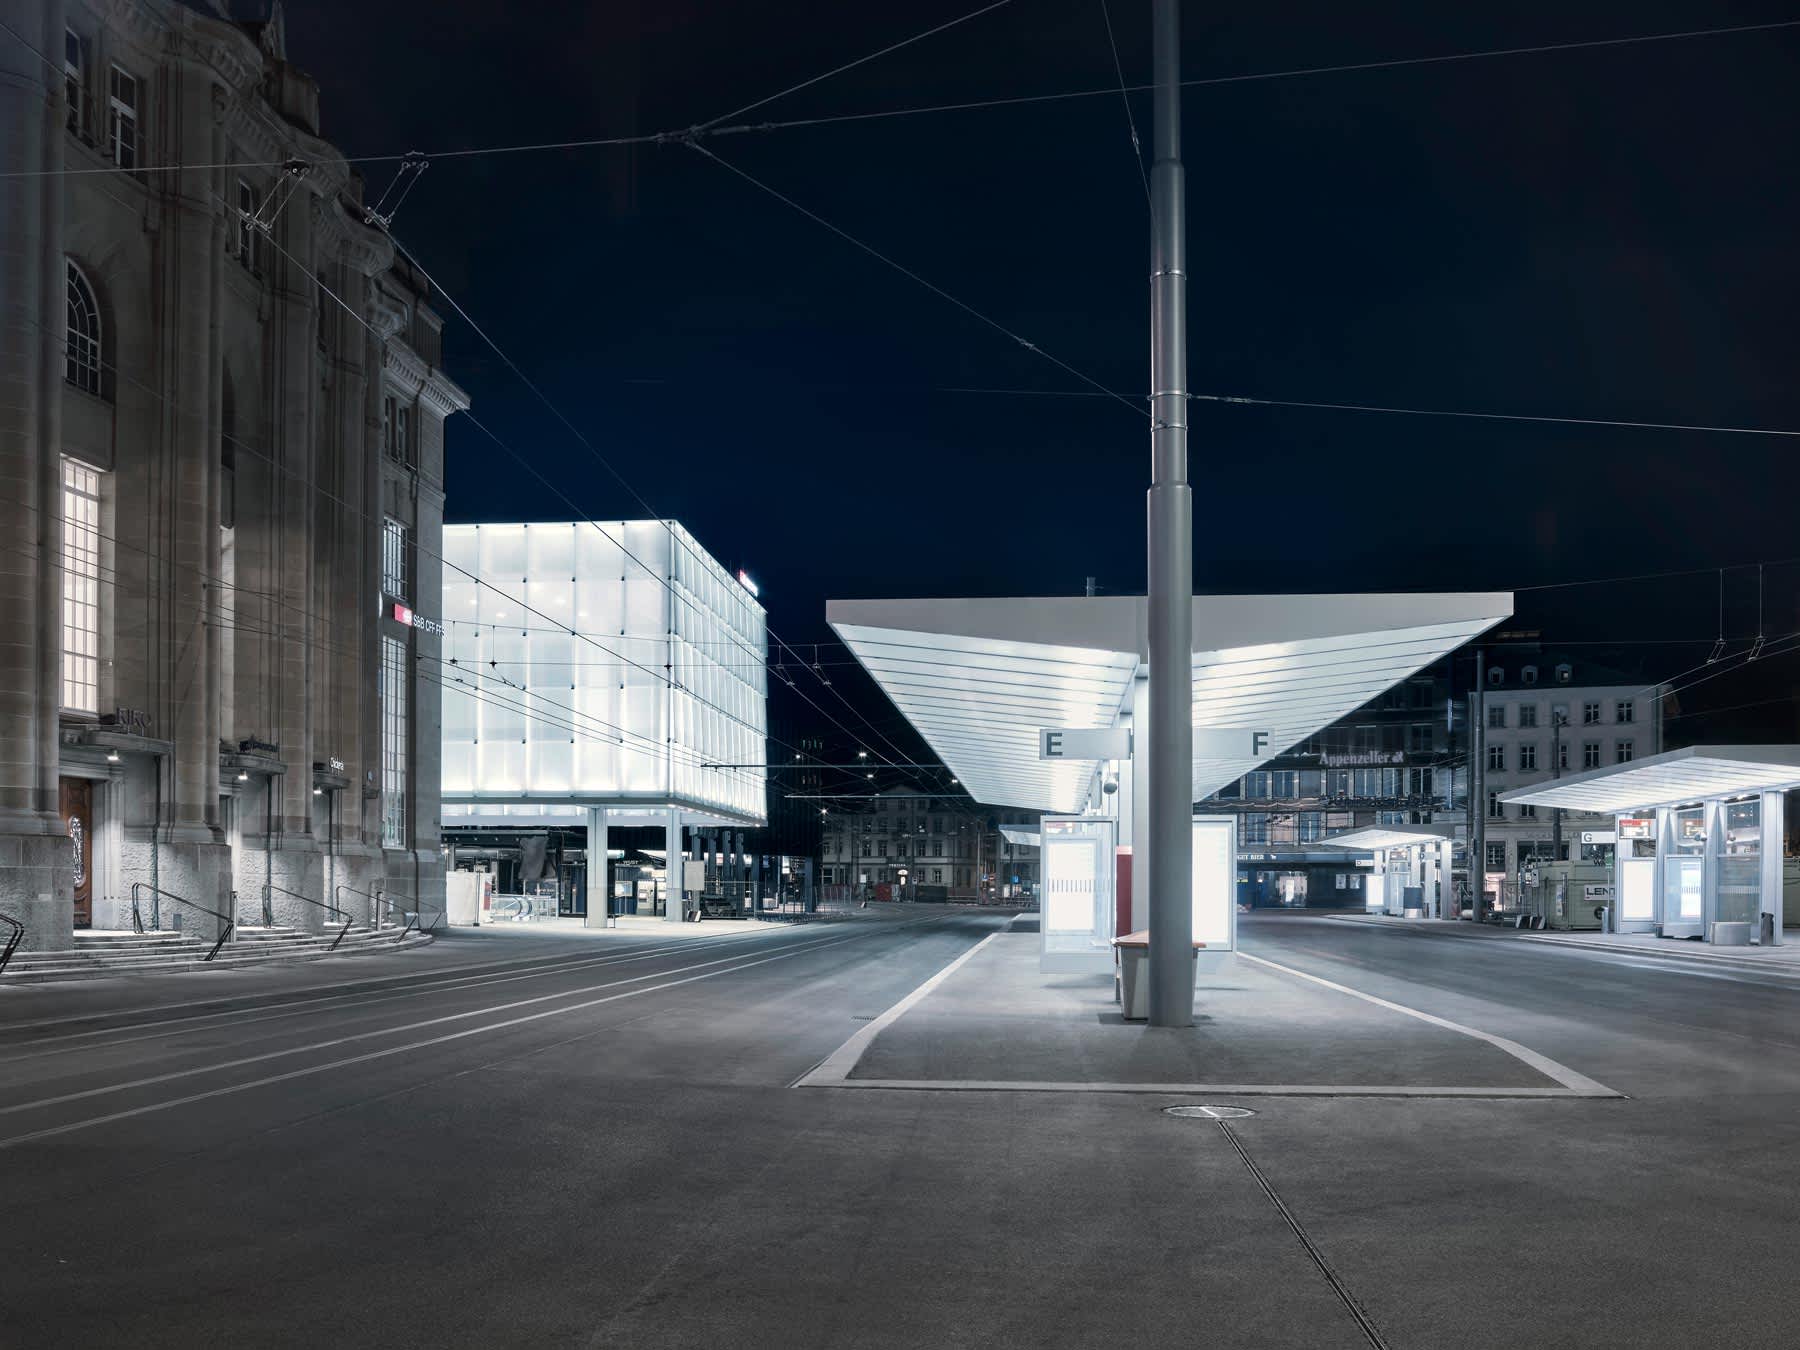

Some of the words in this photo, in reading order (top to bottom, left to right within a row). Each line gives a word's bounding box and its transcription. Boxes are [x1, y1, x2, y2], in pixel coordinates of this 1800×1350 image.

[414, 614, 425, 629] SBB
[425, 619, 435, 633] CFF
[1046, 733, 1063, 756] E
[1252, 732, 1268, 756] F
[1319, 750, 1390, 767] Appenzeller
[1584, 833, 1592, 842] G
